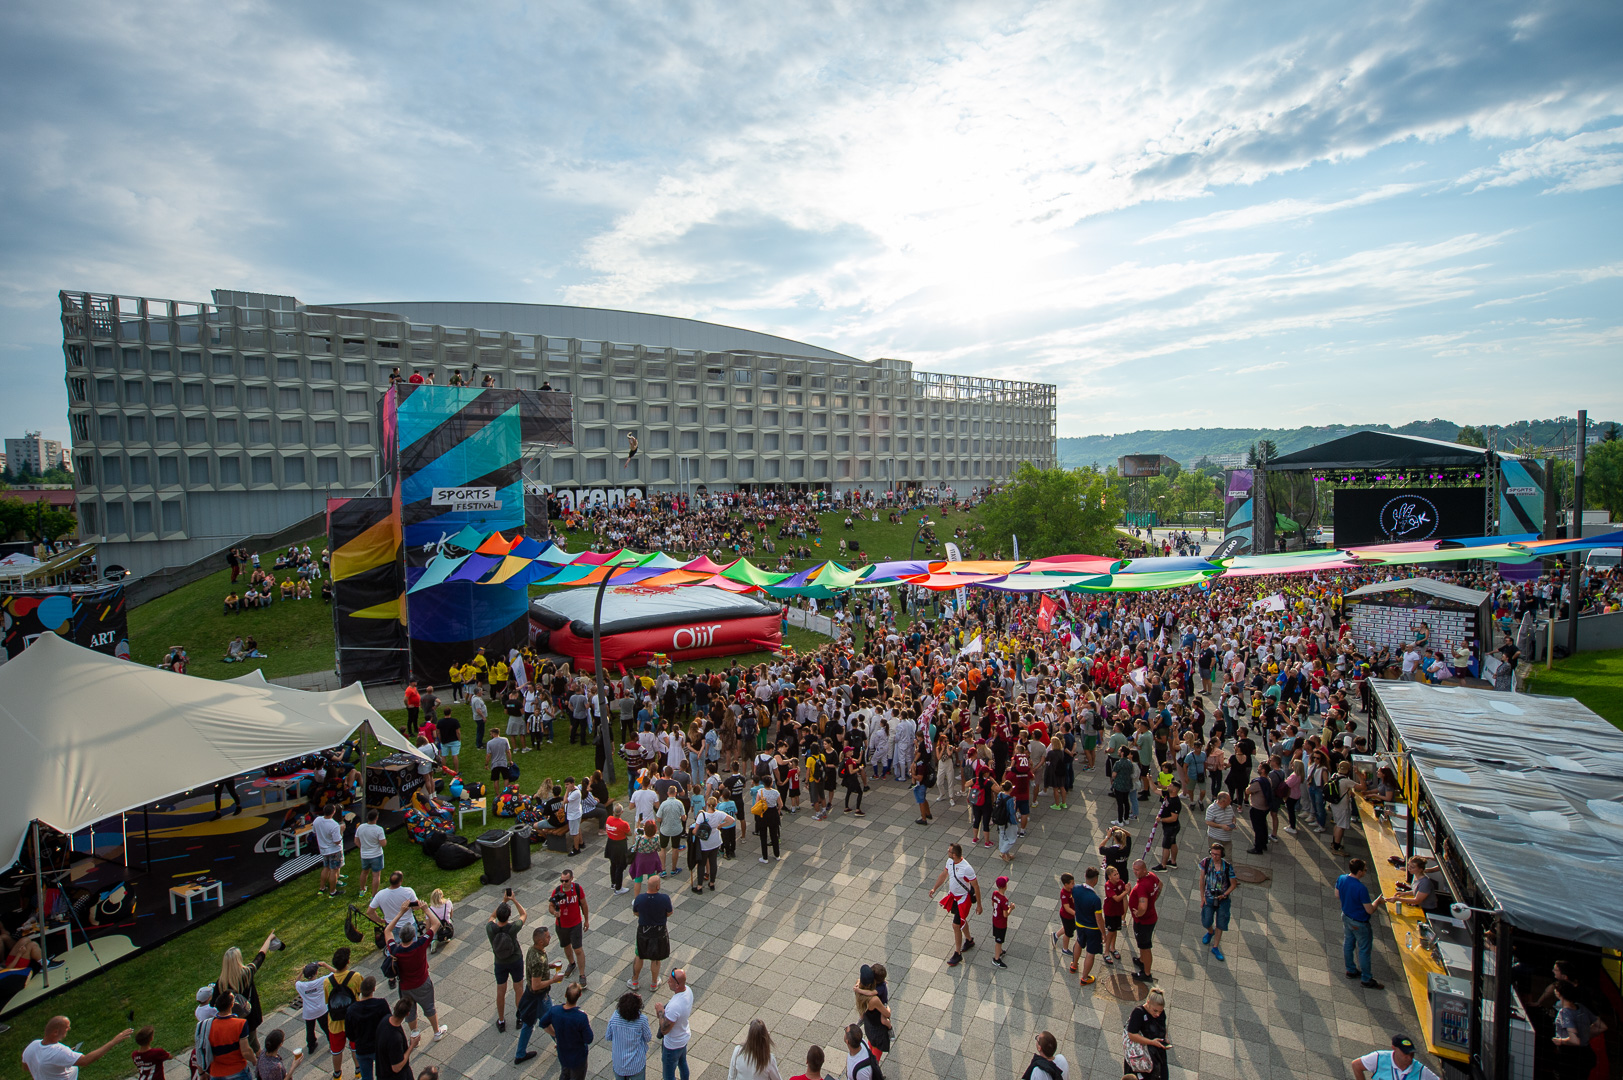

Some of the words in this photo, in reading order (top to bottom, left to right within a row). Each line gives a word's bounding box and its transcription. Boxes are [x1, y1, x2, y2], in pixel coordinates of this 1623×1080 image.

[438, 489, 490, 500] SPORTS
[456, 502, 499, 511] FESTIVAL
[89, 630, 116, 648] ART
[673, 624, 722, 650] aiir
[1018, 757, 1029, 767] 20
[794, 773, 799, 782] 8
[368, 784, 396, 795] CHARGE
